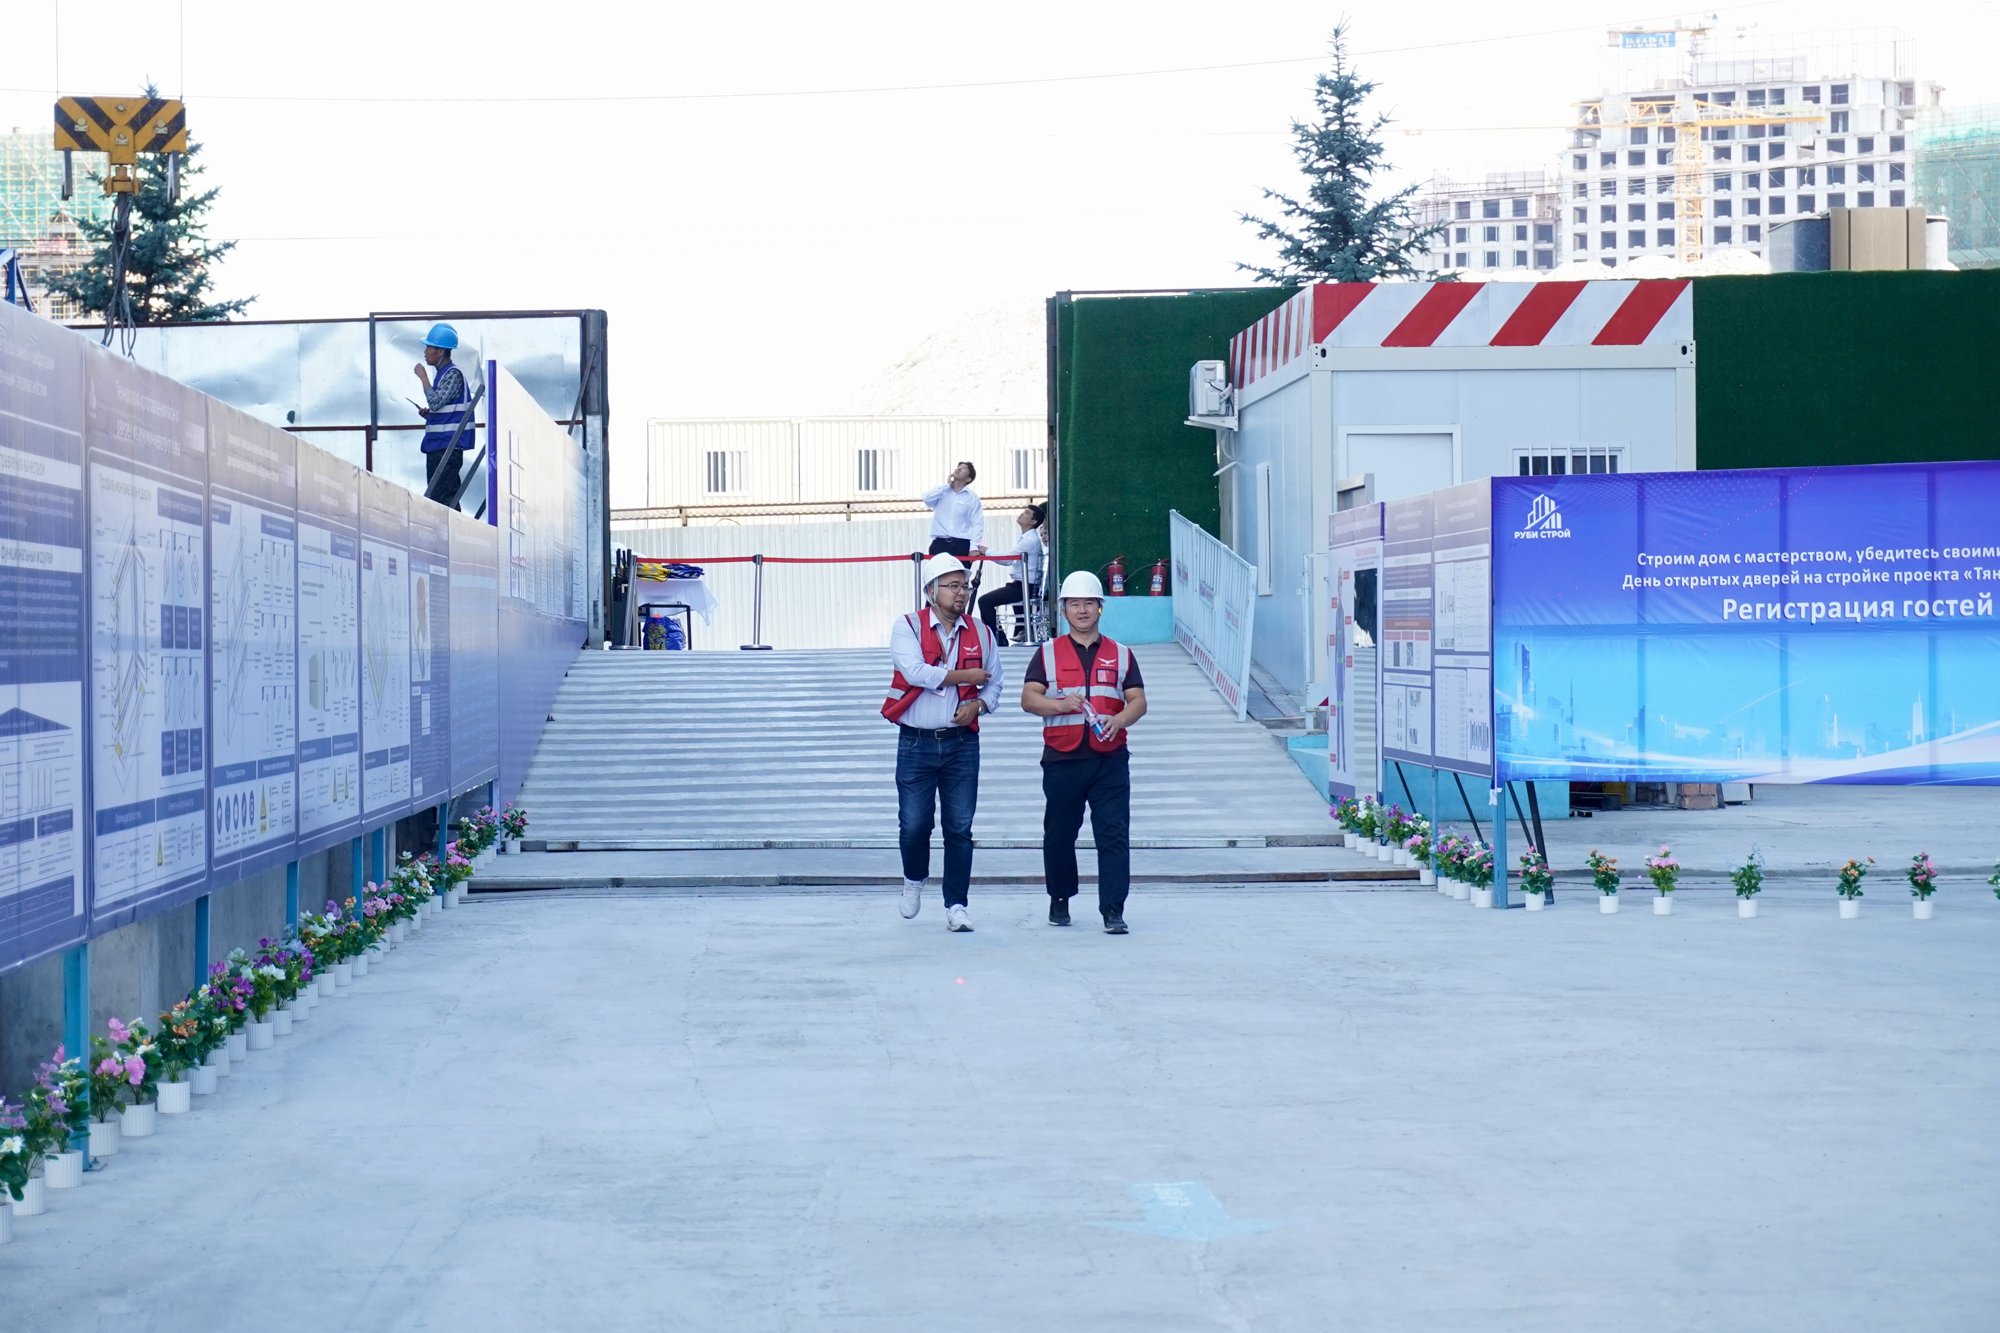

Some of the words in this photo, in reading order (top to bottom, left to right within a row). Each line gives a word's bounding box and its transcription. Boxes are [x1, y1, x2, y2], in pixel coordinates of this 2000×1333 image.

[1514, 531, 1538, 539] РУБИ
[1540, 528, 1571, 539] СТРОЙ
[1637, 552, 1695, 568] Строим
[1698, 552, 1730, 567] дом
[1734, 553, 1742, 564] с
[1744, 550, 1852, 566] мастерством,
[1856, 546, 1940, 564] убедитесь
[1622, 574, 1661, 590] День
[1664, 574, 1740, 589] открытых
[1742, 570, 1800, 588] дверей
[1804, 572, 1822, 584] на
[1826, 568, 1890, 586] стройке
[1894, 569, 1960, 585] проекта
[1722, 598, 1895, 624] Регистрация
[1902, 592, 1993, 617] гостей
